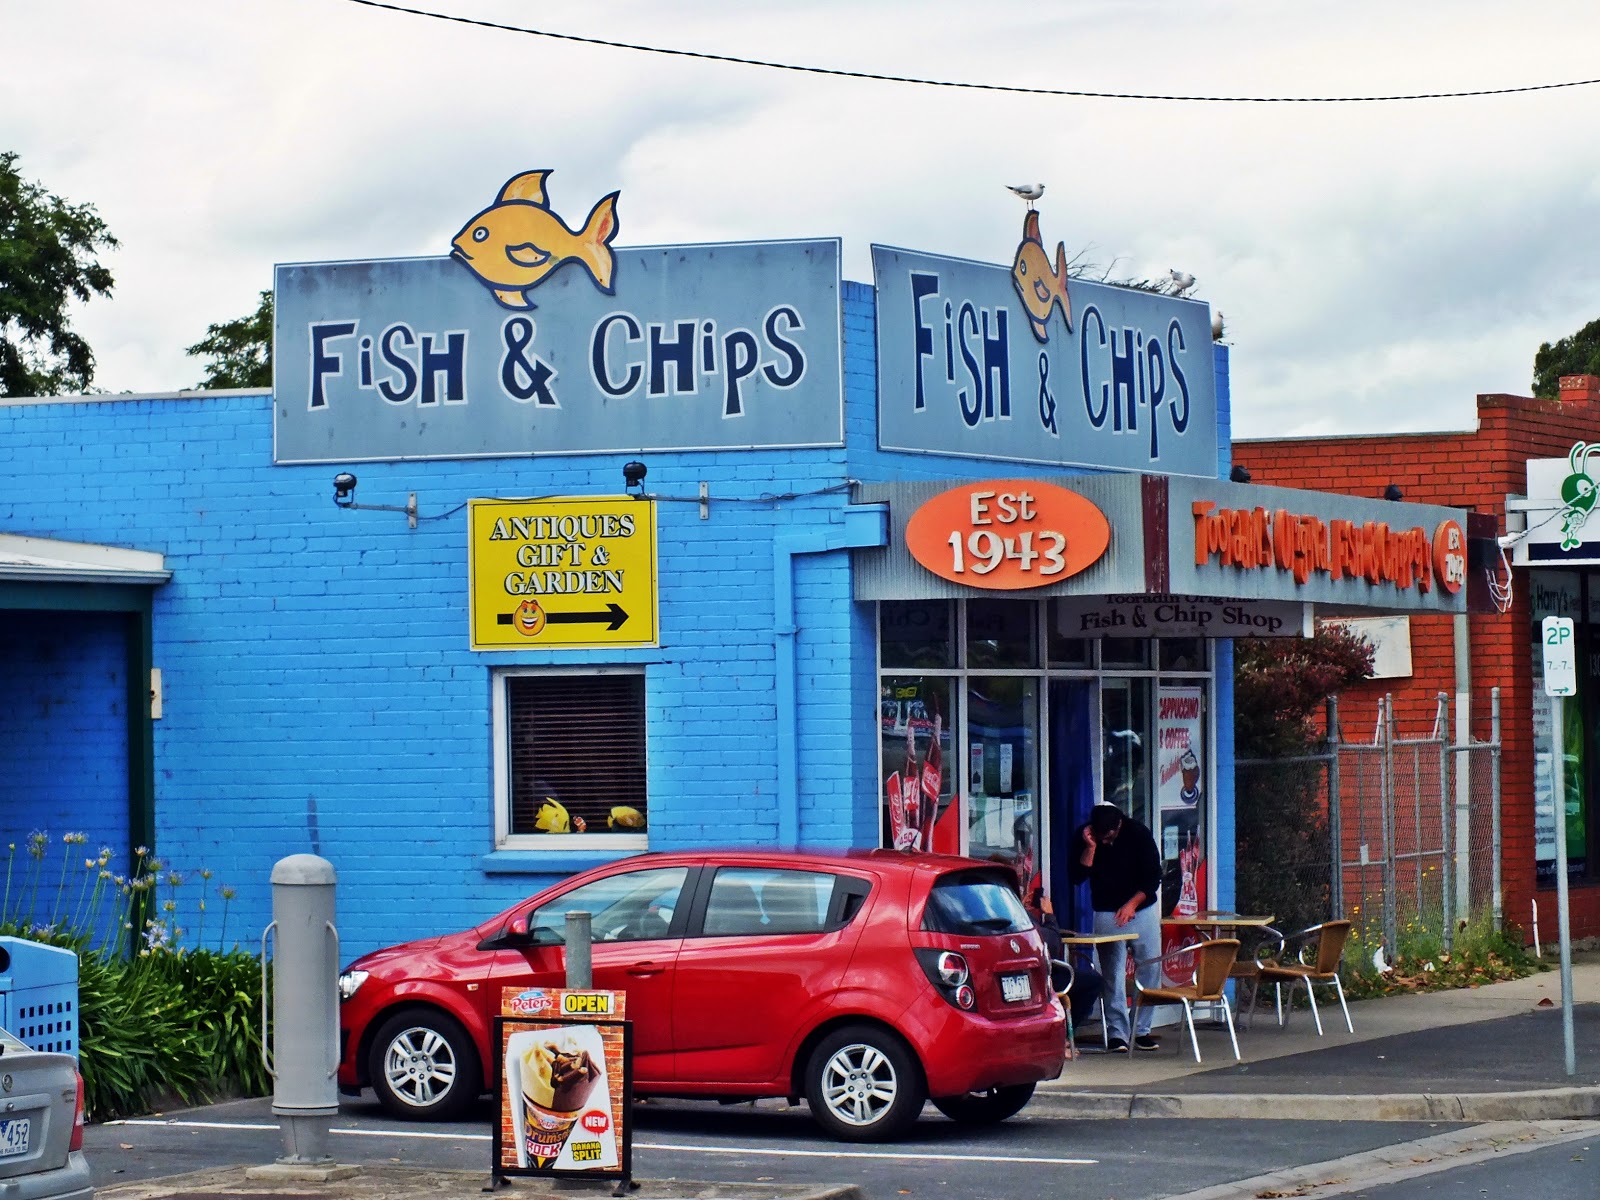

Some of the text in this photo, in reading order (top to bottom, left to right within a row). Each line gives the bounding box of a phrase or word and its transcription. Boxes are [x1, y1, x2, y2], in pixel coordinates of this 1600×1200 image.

[499, 312, 560, 409] &
[1037, 349, 1059, 439] &
[489, 514, 635, 542] ANTIQUES
[517, 542, 610, 567] GIFT &
[948, 530, 1067, 575] 1943
[504, 570, 624, 595] GARDEN
[1080, 604, 1283, 632] Fish & Chip Shop
[1547, 627, 1570, 645] 2P
[511, 996, 552, 1012] Peters
[565, 994, 609, 1013] OPEN
[585, 1116, 606, 1128] NEW
[571, 1141, 601, 1151] BANANA
[573, 1150, 601, 1162] SPLIT
